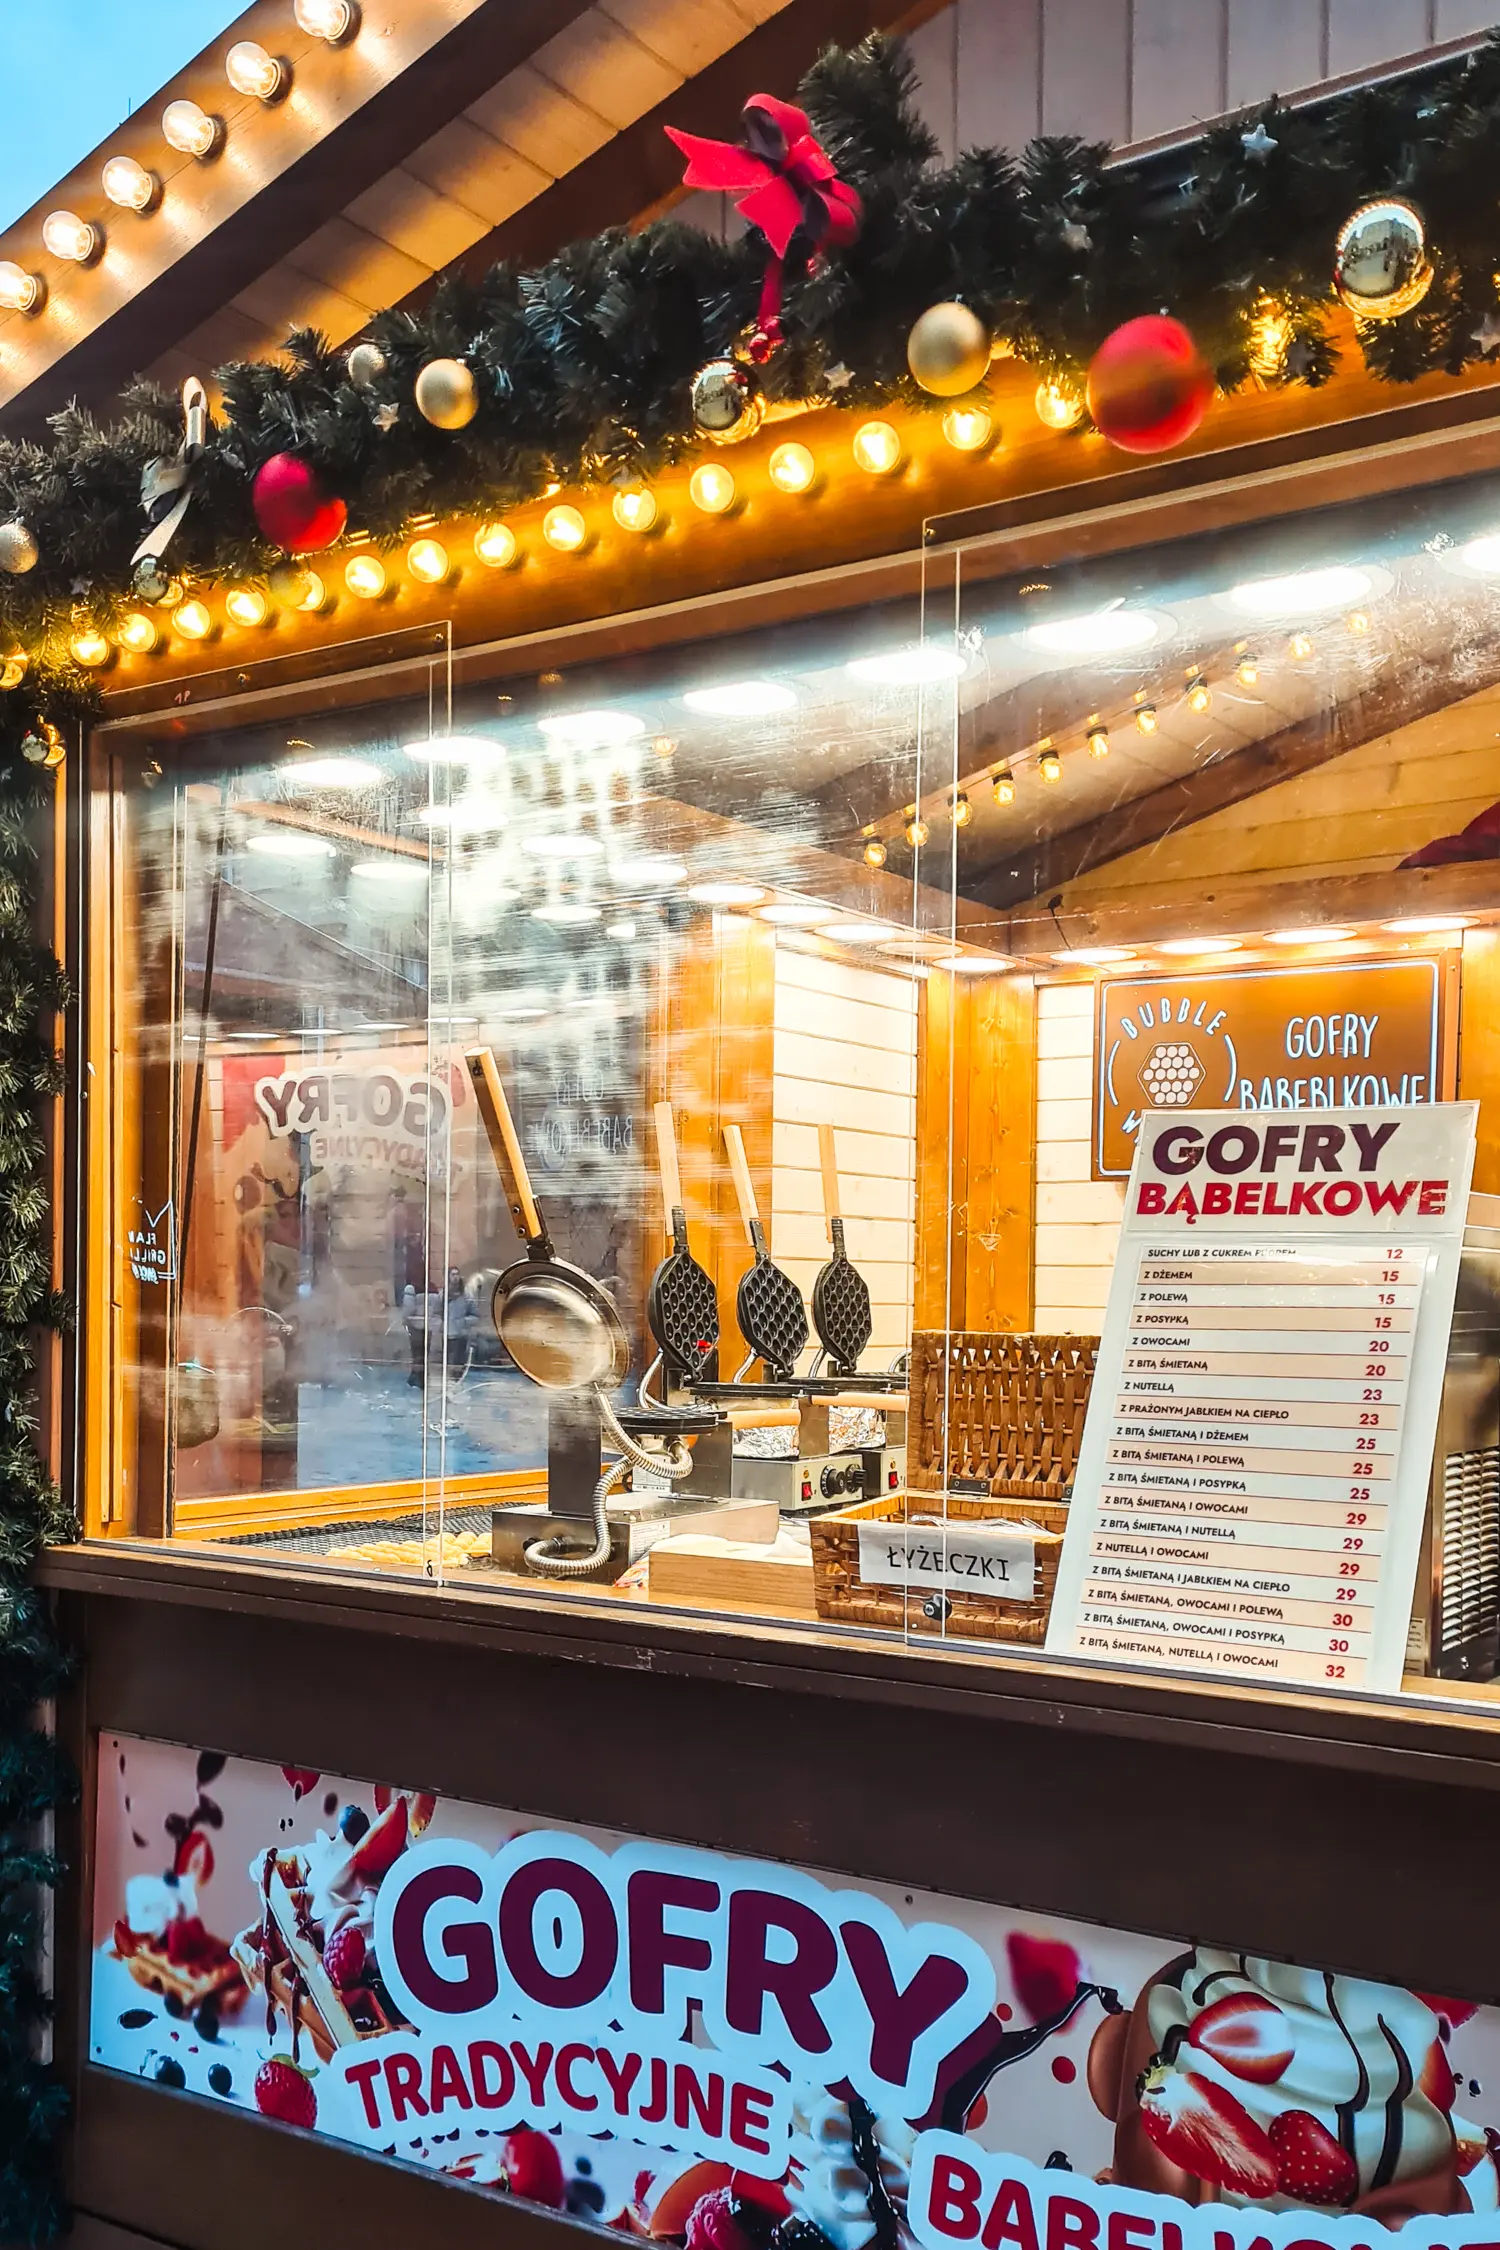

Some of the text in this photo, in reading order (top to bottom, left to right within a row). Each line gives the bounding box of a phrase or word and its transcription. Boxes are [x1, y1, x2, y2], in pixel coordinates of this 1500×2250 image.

[1120, 996, 1229, 1041] BUBBLE
[1285, 1013, 1379, 1059] GOFRY
[1152, 1122, 1401, 1175] GOFRY
[1135, 1180, 1449, 1225] BĄBELKOWE
[1147, 1249, 1181, 1257] SUCHY
[1182, 1249, 1201, 1257] LUB
[1202, 1249, 1210, 1257] Z
[1211, 1249, 1252, 1257] CUKREM
[1386, 1248, 1404, 1260] 12
[1143, 1269, 1400, 1282] Z DŻEMEM 15
[1140, 1293, 1396, 1305] Z POLEWĄ 15
[1136, 1315, 1392, 1329] Z POSYPKĄ 15
[1132, 1337, 1390, 1353] Z OWOCAMI 20
[1128, 1357, 1386, 1377] Z BITĄ ŚMIETANĄ 20
[1124, 1382, 1383, 1401] Z NUTELLĄ 23
[1120, 1403, 1380, 1426] Z PRAŻONYM JABŁKIEM NA CIEPŁO 23
[1116, 1426, 1123, 1435] Z
[1124, 1427, 1145, 1438] BITĄ
[1147, 1425, 1197, 1441] ŚMIETANĄ
[1205, 1428, 1249, 1441] DŻEMEM
[1355, 1437, 1377, 1450] 25
[1112, 1449, 1120, 1458] Z
[1121, 1450, 1142, 1461] BITĄ
[1143, 1449, 1194, 1465] ŚMIETANĄ
[1202, 1455, 1245, 1467] POLEWĄ
[1352, 1462, 1373, 1475] 25
[1108, 1472, 1116, 1481] Z
[1117, 1473, 1138, 1485] BITĄ
[1140, 1472, 1190, 1488] ŚMIETANĄ
[1199, 1478, 1247, 1492] POSYPKĄ
[1349, 1487, 1370, 1500] 25
[1104, 1495, 1112, 1504] Z
[1113, 1496, 1134, 1507] BITĄ
[1136, 1495, 1186, 1511] ŚMIETANĄ
[1195, 1502, 1249, 1515] OWOCAMI
[1345, 1512, 1367, 1525] 29
[1100, 1518, 1108, 1527] Z
[1109, 1519, 1130, 1531] BITĄ
[1132, 1518, 1183, 1535] ŚMIETANĄ
[1191, 1526, 1236, 1540] NUTELLĄ
[1342, 1537, 1364, 1550] 29
[886, 1545, 1010, 1582] ŁYŻECZKI
[1096, 1542, 1103, 1551] Z
[1105, 1543, 1148, 1557] NUTELLĄ
[1156, 1547, 1209, 1560] OWOCAMI
[1338, 1562, 1360, 1576] 29
[1092, 1565, 1100, 1574] Z
[1101, 1566, 1123, 1578] BITĄ
[1124, 1566, 1175, 1584] ŚMIETANĄ
[1181, 1574, 1232, 1587] JABŁKIEM
[1234, 1579, 1250, 1589] NA
[1252, 1580, 1291, 1593] CIEPŁO
[1335, 1587, 1357, 1601] 29
[1087, 1589, 1095, 1598] Z
[1096, 1589, 1118, 1602] BITĄ
[1120, 1589, 1174, 1608] ŚMIETANĄ,
[1176, 1598, 1230, 1612] OWOCAMI
[1239, 1604, 1284, 1620] POLEWĄ
[1332, 1613, 1353, 1627] 30
[1083, 1613, 1091, 1622] Z
[1092, 1614, 1114, 1626] BITĄ
[1115, 1613, 1170, 1632] ŚMIETANĄ,
[1172, 1622, 1226, 1637] OWOCAMI
[1235, 1629, 1286, 1645] POSYPKĄ
[1328, 1639, 1349, 1653] 30
[1079, 1636, 1087, 1646] Z
[1088, 1637, 1109, 1650] BITĄ
[1111, 1638, 1165, 1657] ŚMIETANĄ,
[1168, 1646, 1214, 1662] NUTELLĄ
[1222, 1653, 1279, 1669] OWOCAMI
[1324, 1664, 1346, 1679] 32
[392, 1857, 969, 2088] GOFRY
[344, 2039, 774, 2155] TRADYCYJNE
